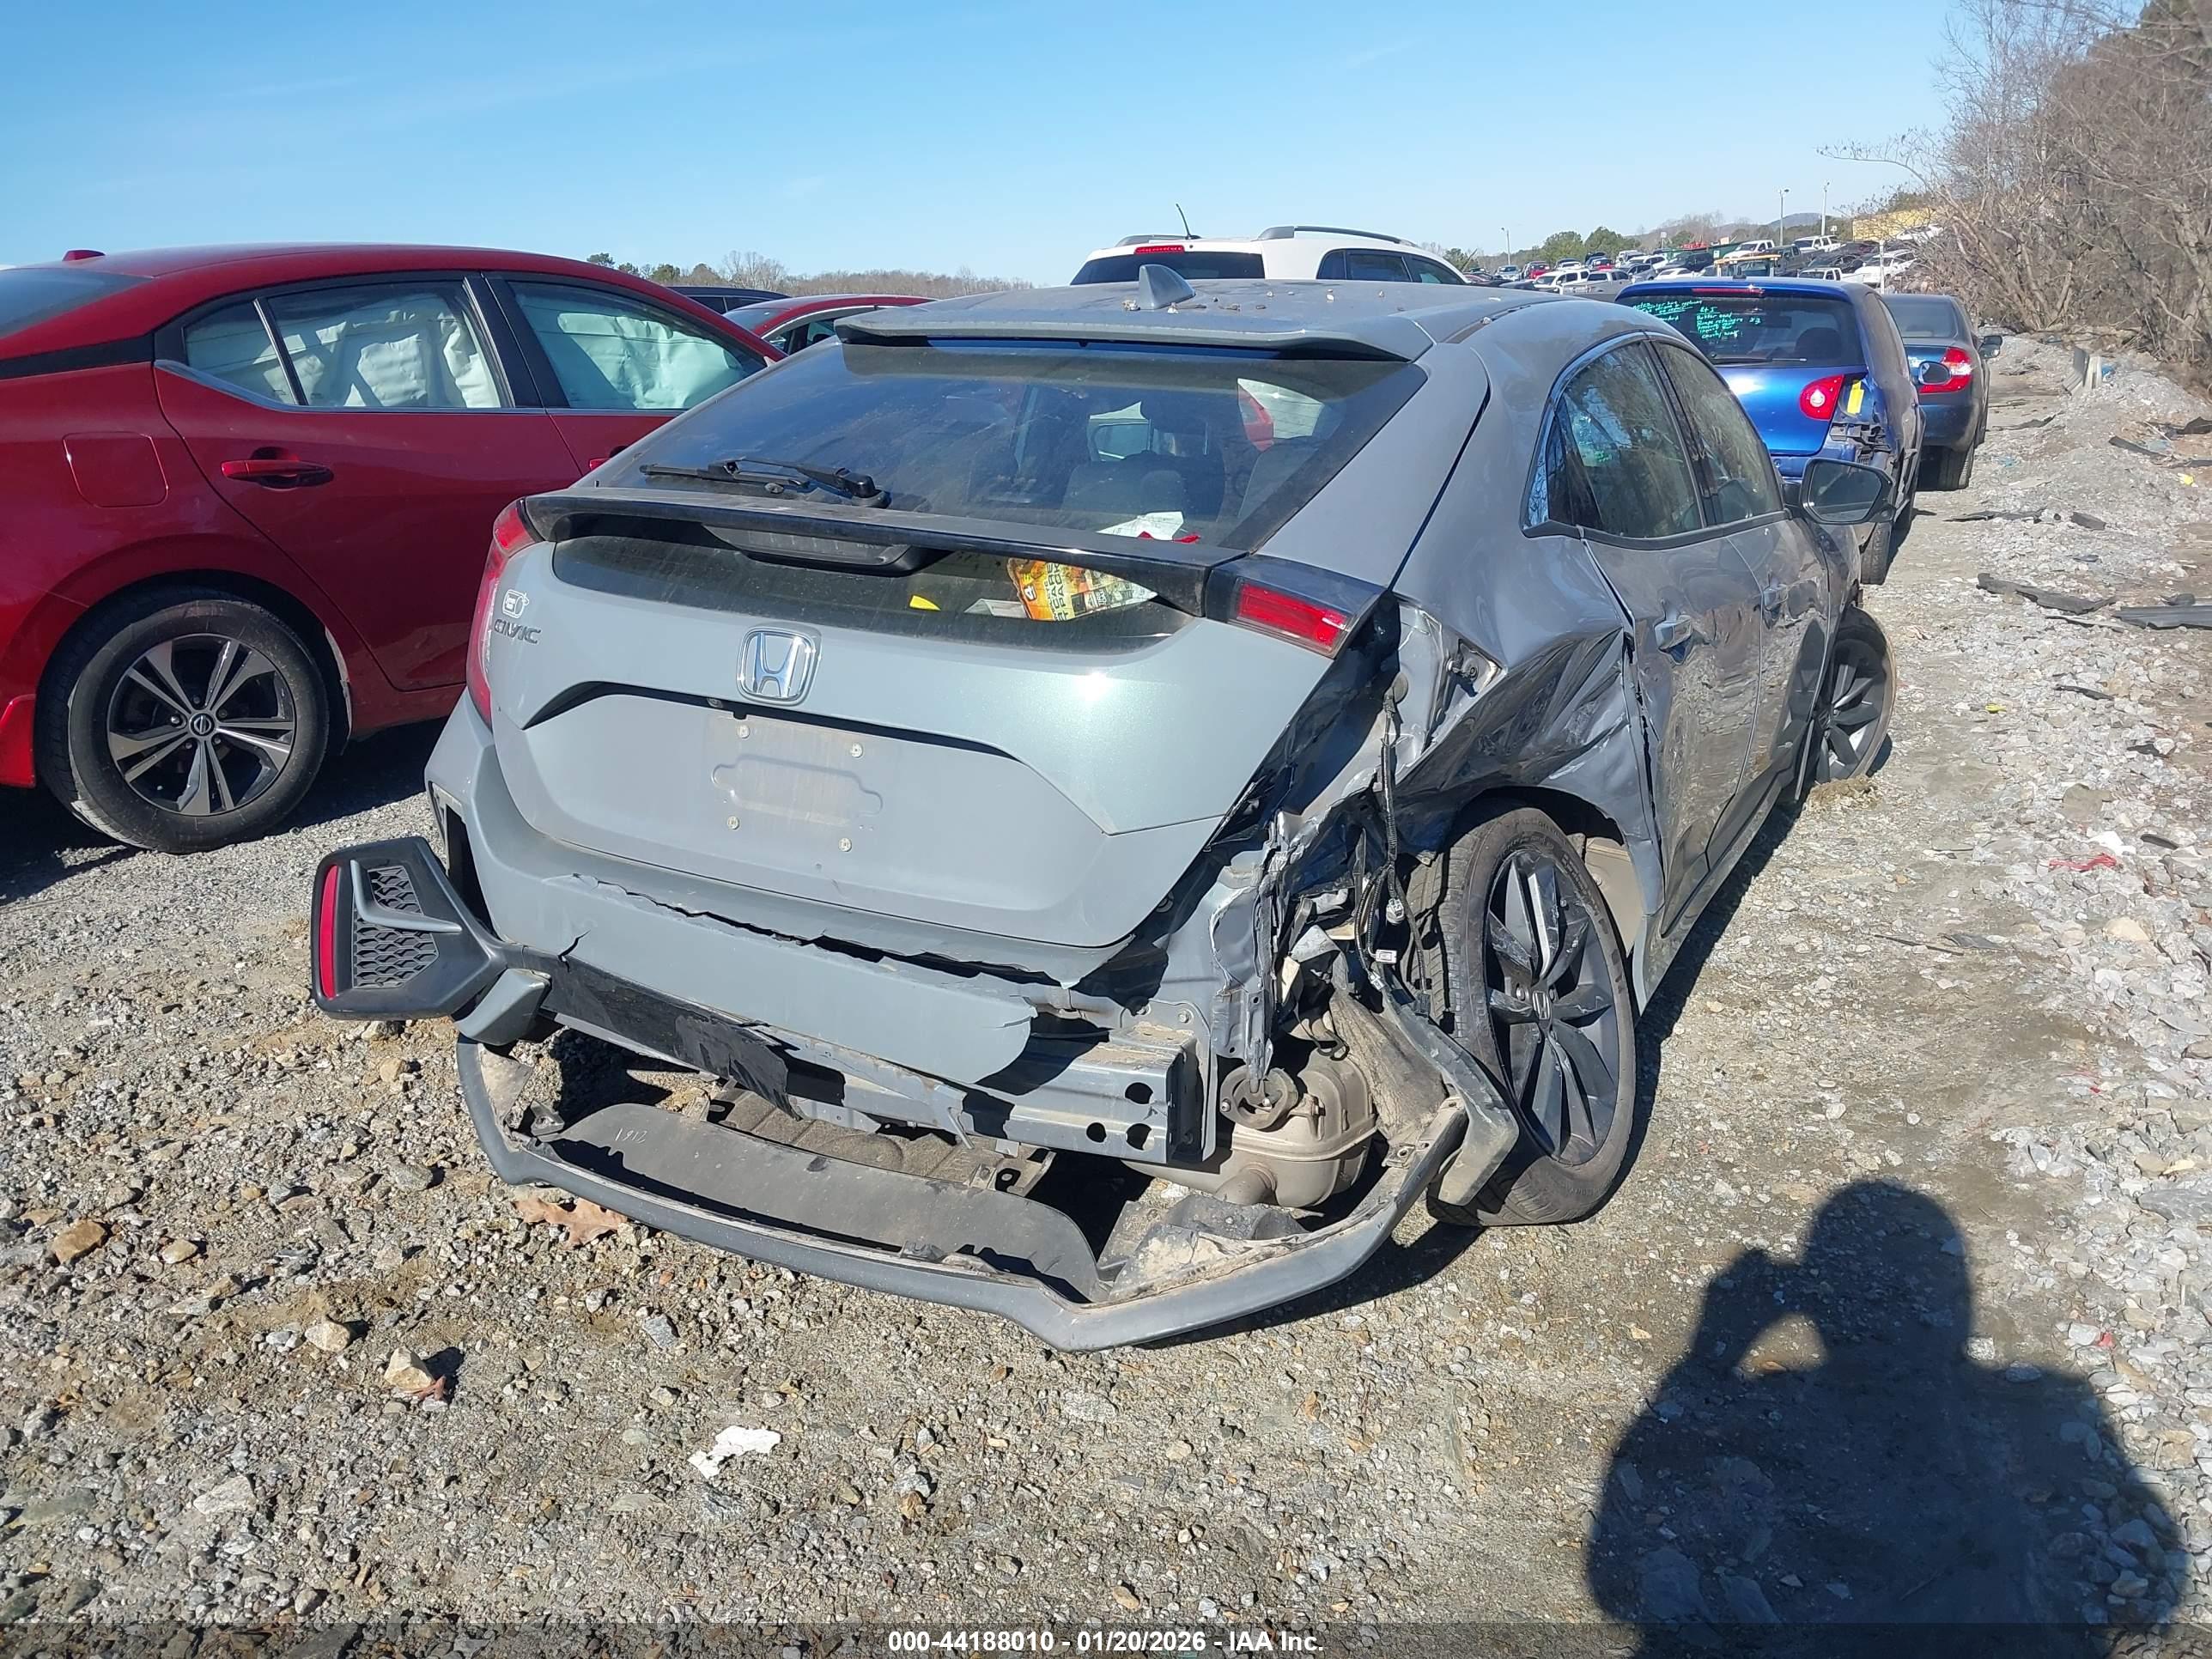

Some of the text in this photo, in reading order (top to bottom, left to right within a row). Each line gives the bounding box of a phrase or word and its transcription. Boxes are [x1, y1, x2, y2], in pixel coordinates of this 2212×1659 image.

[1044, 580, 1057, 620] OMPLETE
[1048, 562, 1060, 609] CARE
[1054, 563, 1066, 608] PACK
[494, 618, 542, 644] CIVIC
